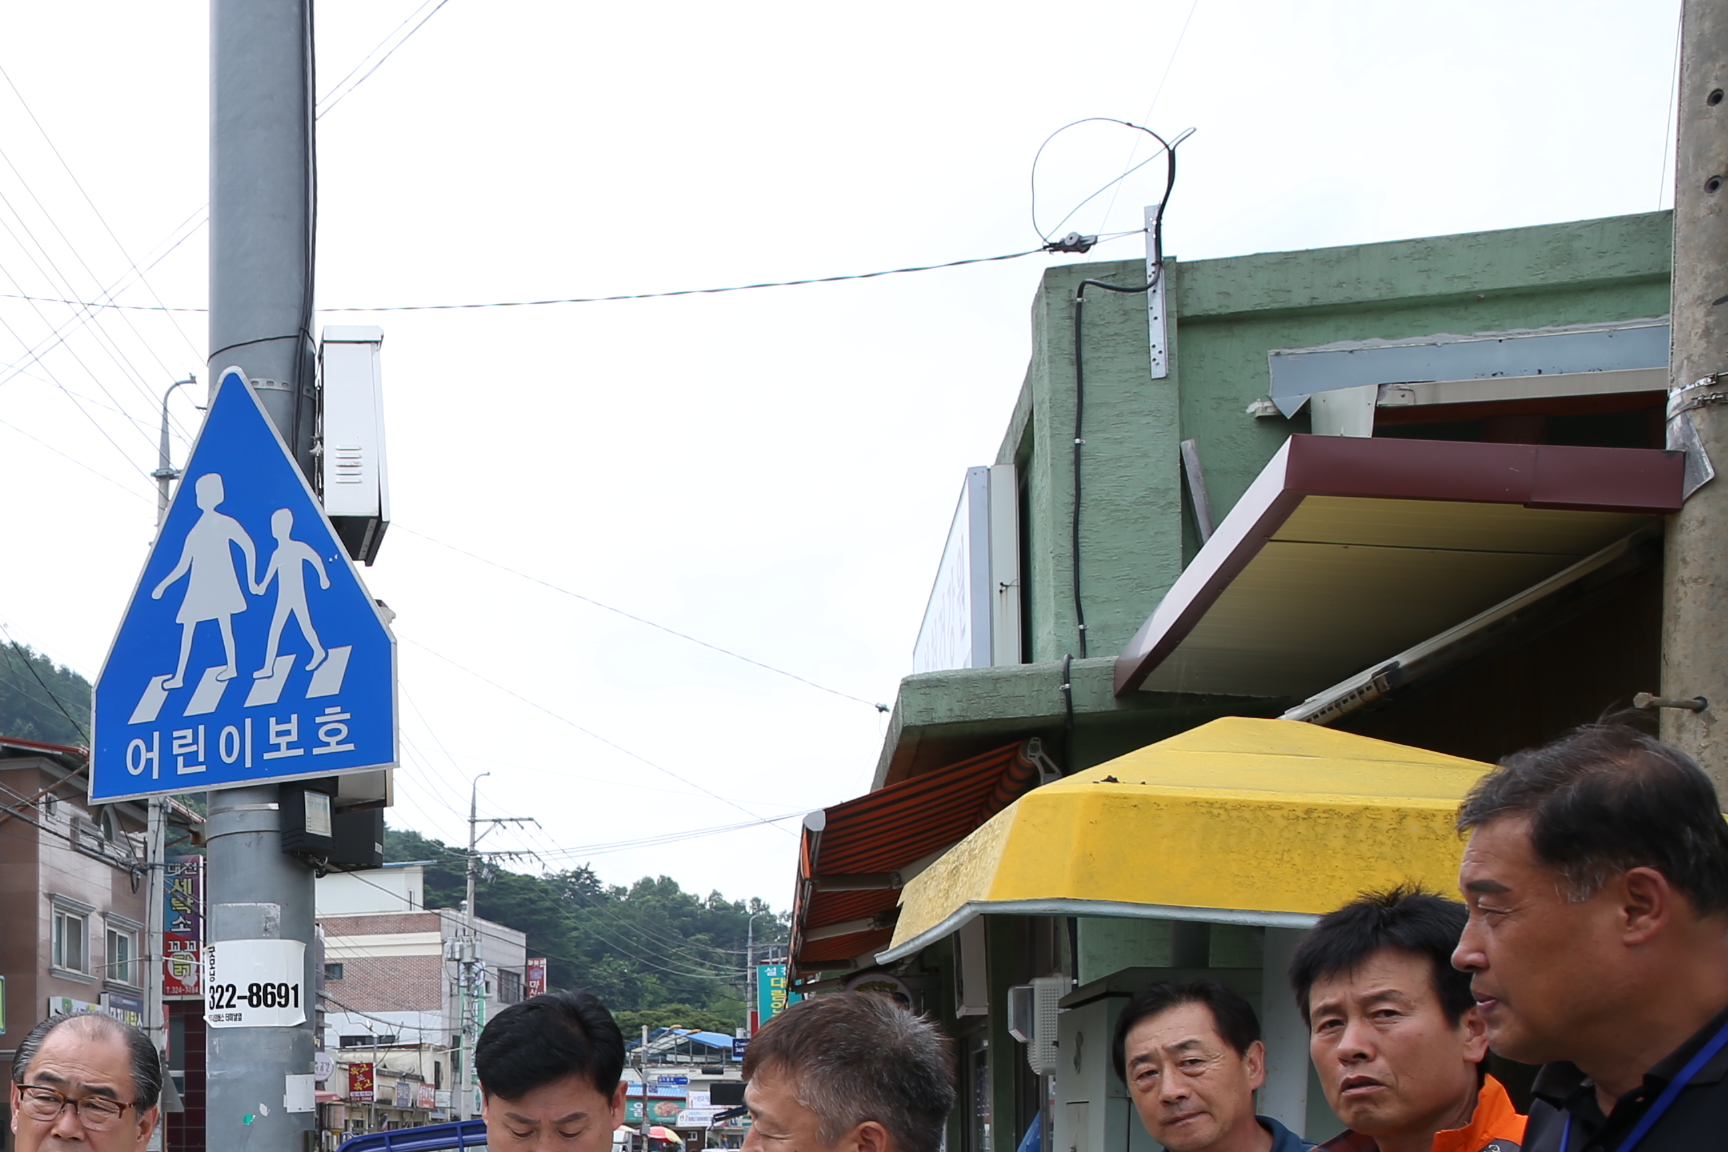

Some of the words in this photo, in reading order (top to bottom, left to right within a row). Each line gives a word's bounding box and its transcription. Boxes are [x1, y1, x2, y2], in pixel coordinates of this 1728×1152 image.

[126, 706, 355, 779] 어린이보호
[170, 878, 194, 932] 세탁소
[167, 940, 198, 953] 꼬꼬
[209, 982, 299, 1010] 322-8691
